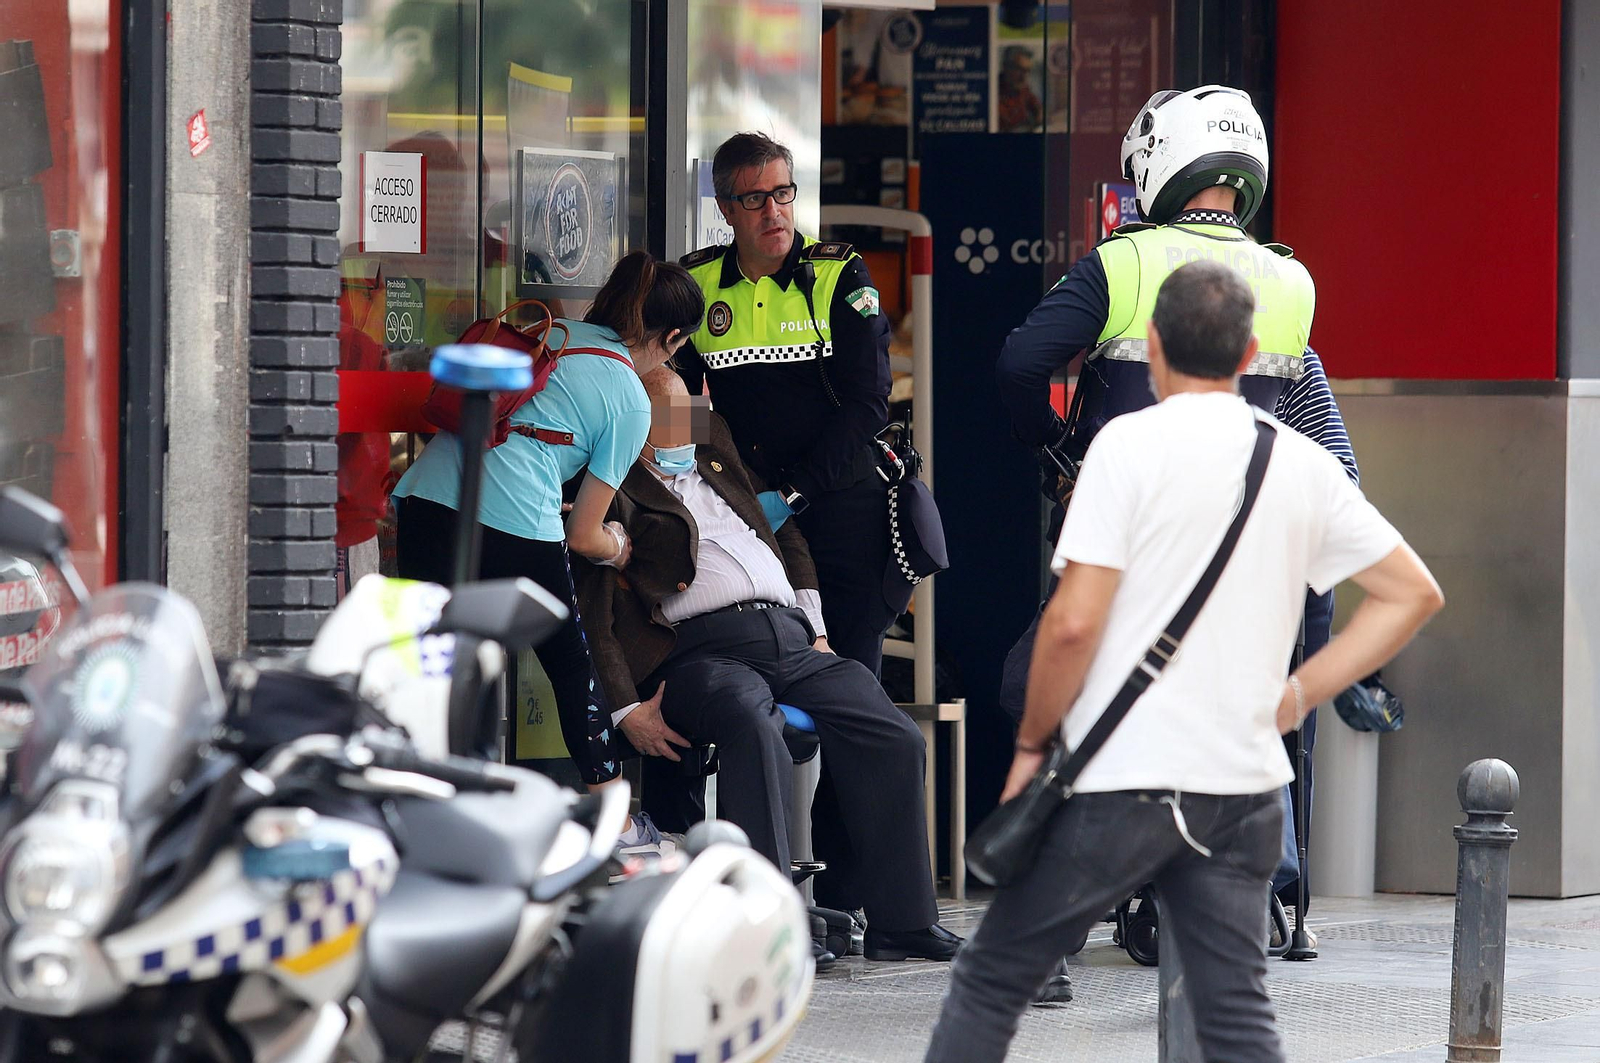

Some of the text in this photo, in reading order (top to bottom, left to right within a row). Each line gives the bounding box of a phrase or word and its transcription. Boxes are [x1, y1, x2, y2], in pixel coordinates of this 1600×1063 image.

[1206, 119, 1264, 144] POLICIA
[374, 177, 414, 197] ACCESO
[370, 204, 418, 225] CERRADO
[560, 207, 579, 236] FOR
[559, 226, 583, 258] FOOD
[387, 280, 406, 289] Prohibido
[780, 318, 828, 333] POLICIA
